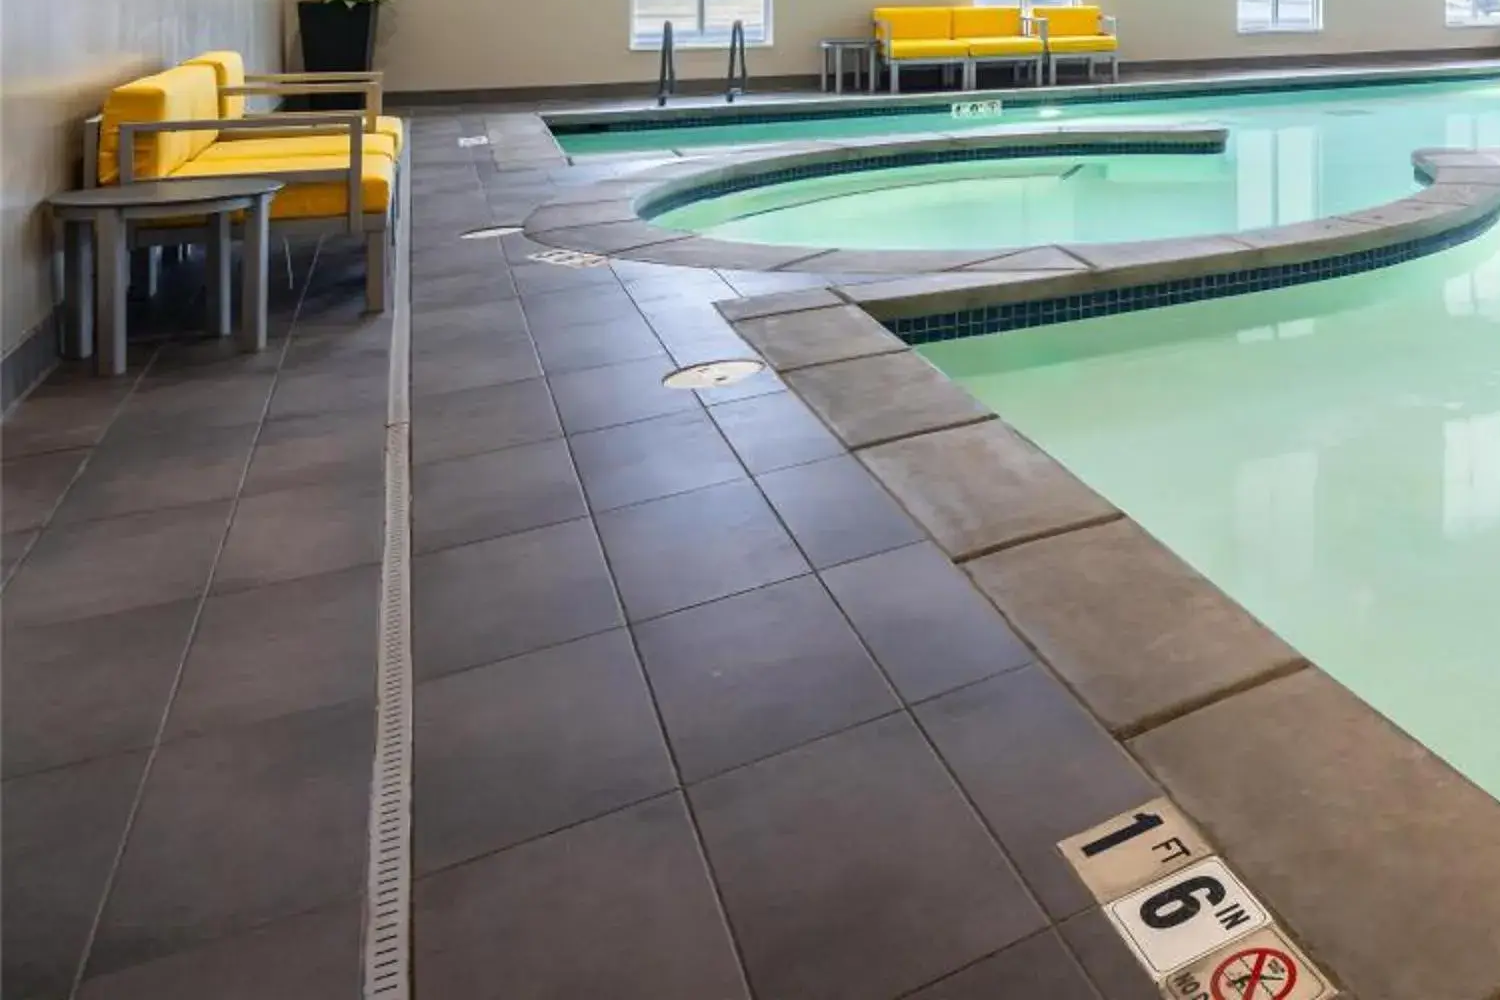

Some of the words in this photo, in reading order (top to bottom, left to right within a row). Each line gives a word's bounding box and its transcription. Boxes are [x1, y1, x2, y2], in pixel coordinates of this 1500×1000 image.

[1081, 812, 1164, 857] 1
[1151, 836, 1191, 863] FT
[1139, 875, 1226, 929] 6
[1215, 902, 1251, 931] IN
[1174, 971, 1201, 996] NO
